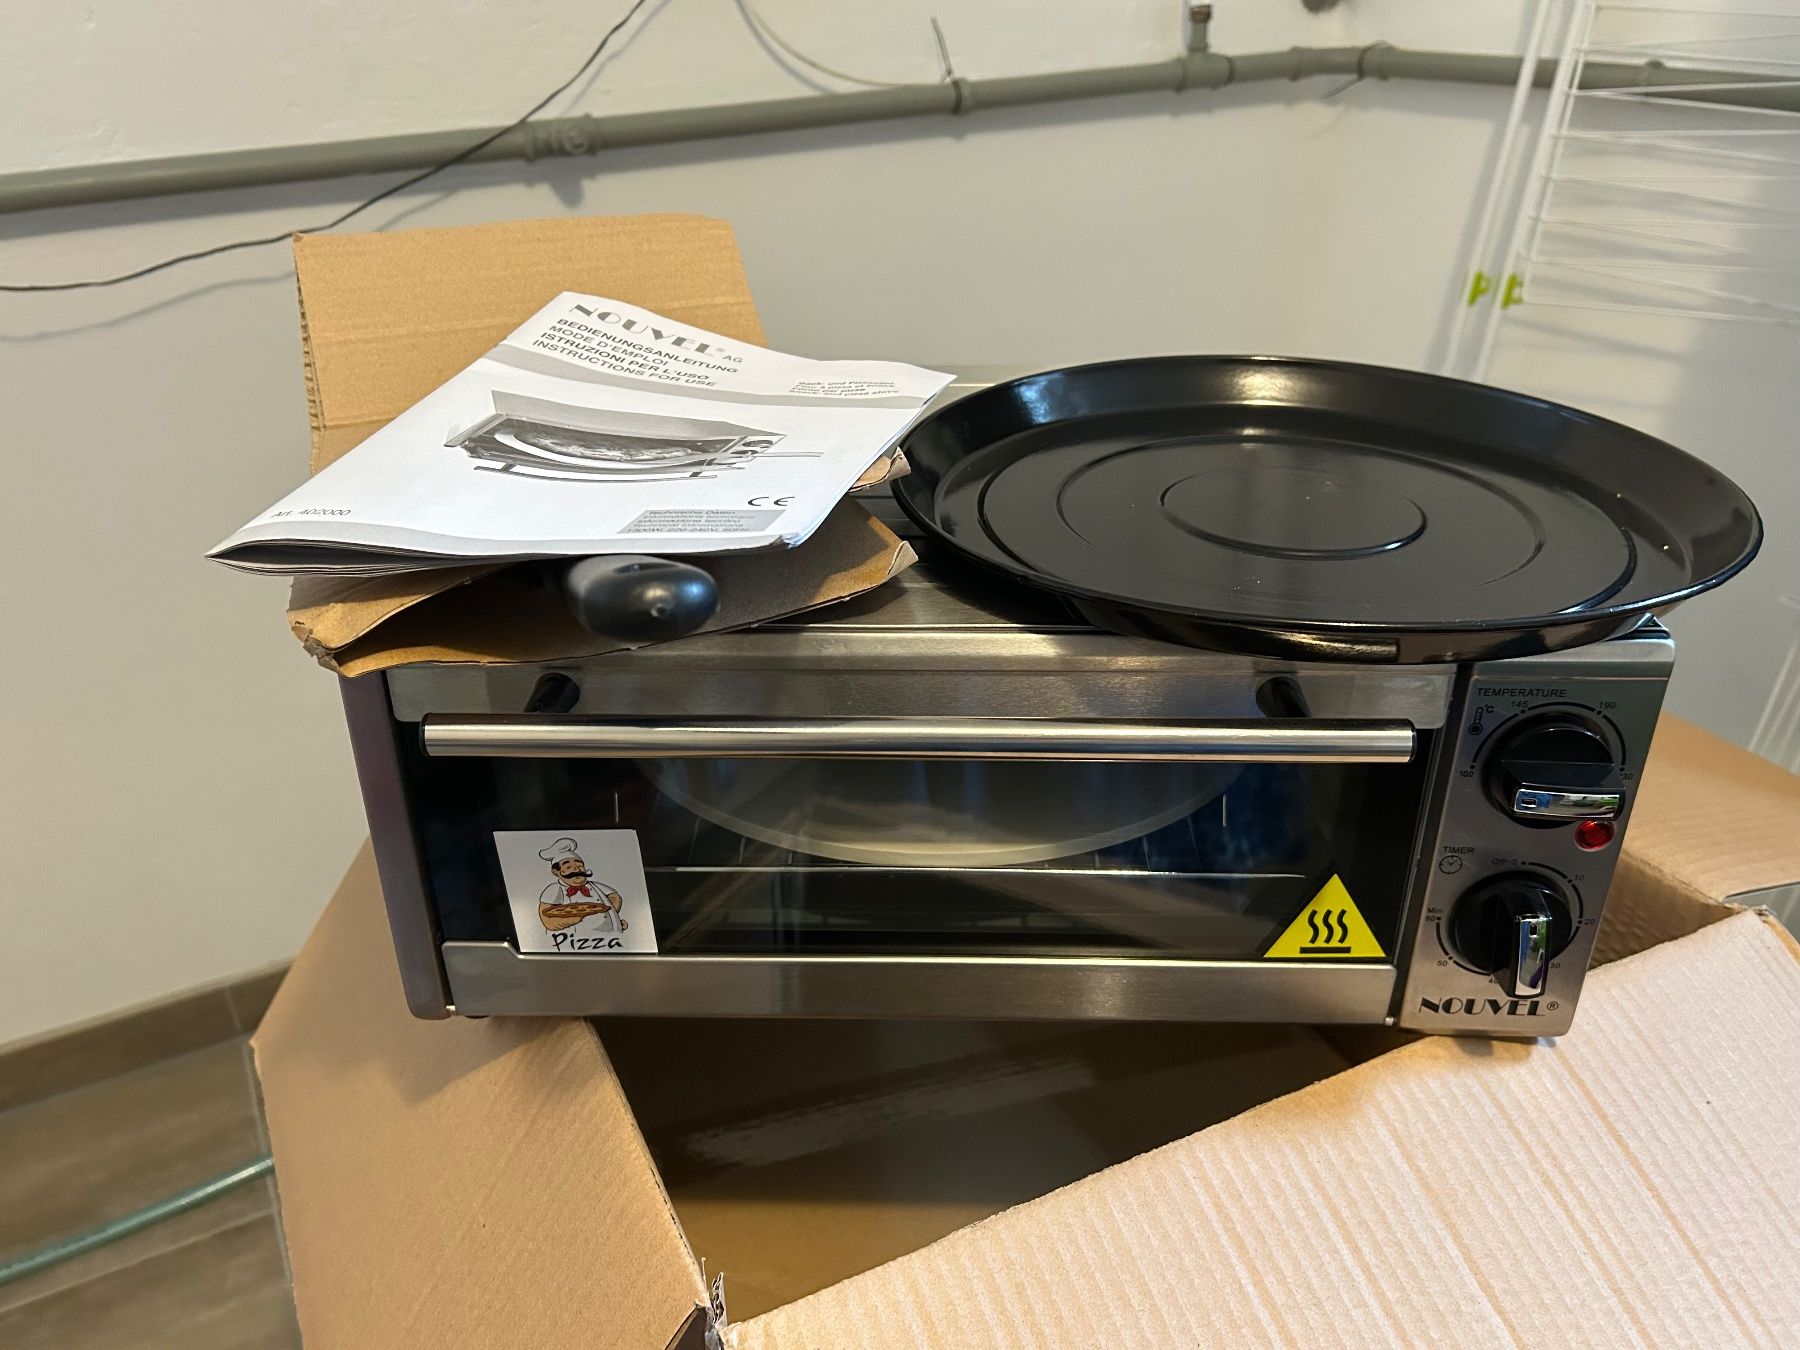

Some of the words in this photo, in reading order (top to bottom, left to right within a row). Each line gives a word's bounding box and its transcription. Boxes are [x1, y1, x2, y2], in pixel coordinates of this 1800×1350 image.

[549, 325, 595, 344] MODE
[601, 340, 669, 367] D'EMPLOI
[557, 318, 739, 373] BEDIENUNGSANLEITUNG
[540, 332, 625, 364] ISTRUZIONI
[628, 359, 661, 373] PER
[663, 368, 710, 380] L'USO
[722, 355, 744, 364] AG
[532, 339, 645, 377] INSTRUCTIONS
[648, 372, 683, 383] FOR
[684, 379, 718, 388] USE
[747, 496, 795, 506] CE
[1477, 687, 1568, 698] TEMPERATURE
[1511, 700, 1529, 709] 145
[1599, 701, 1616, 710] 190
[1460, 770, 1474, 778] 100
[1443, 846, 1474, 854] TIMER
[1574, 874, 1585, 882] 10
[1584, 918, 1596, 926] 20
[551, 932, 624, 951] Pizza
